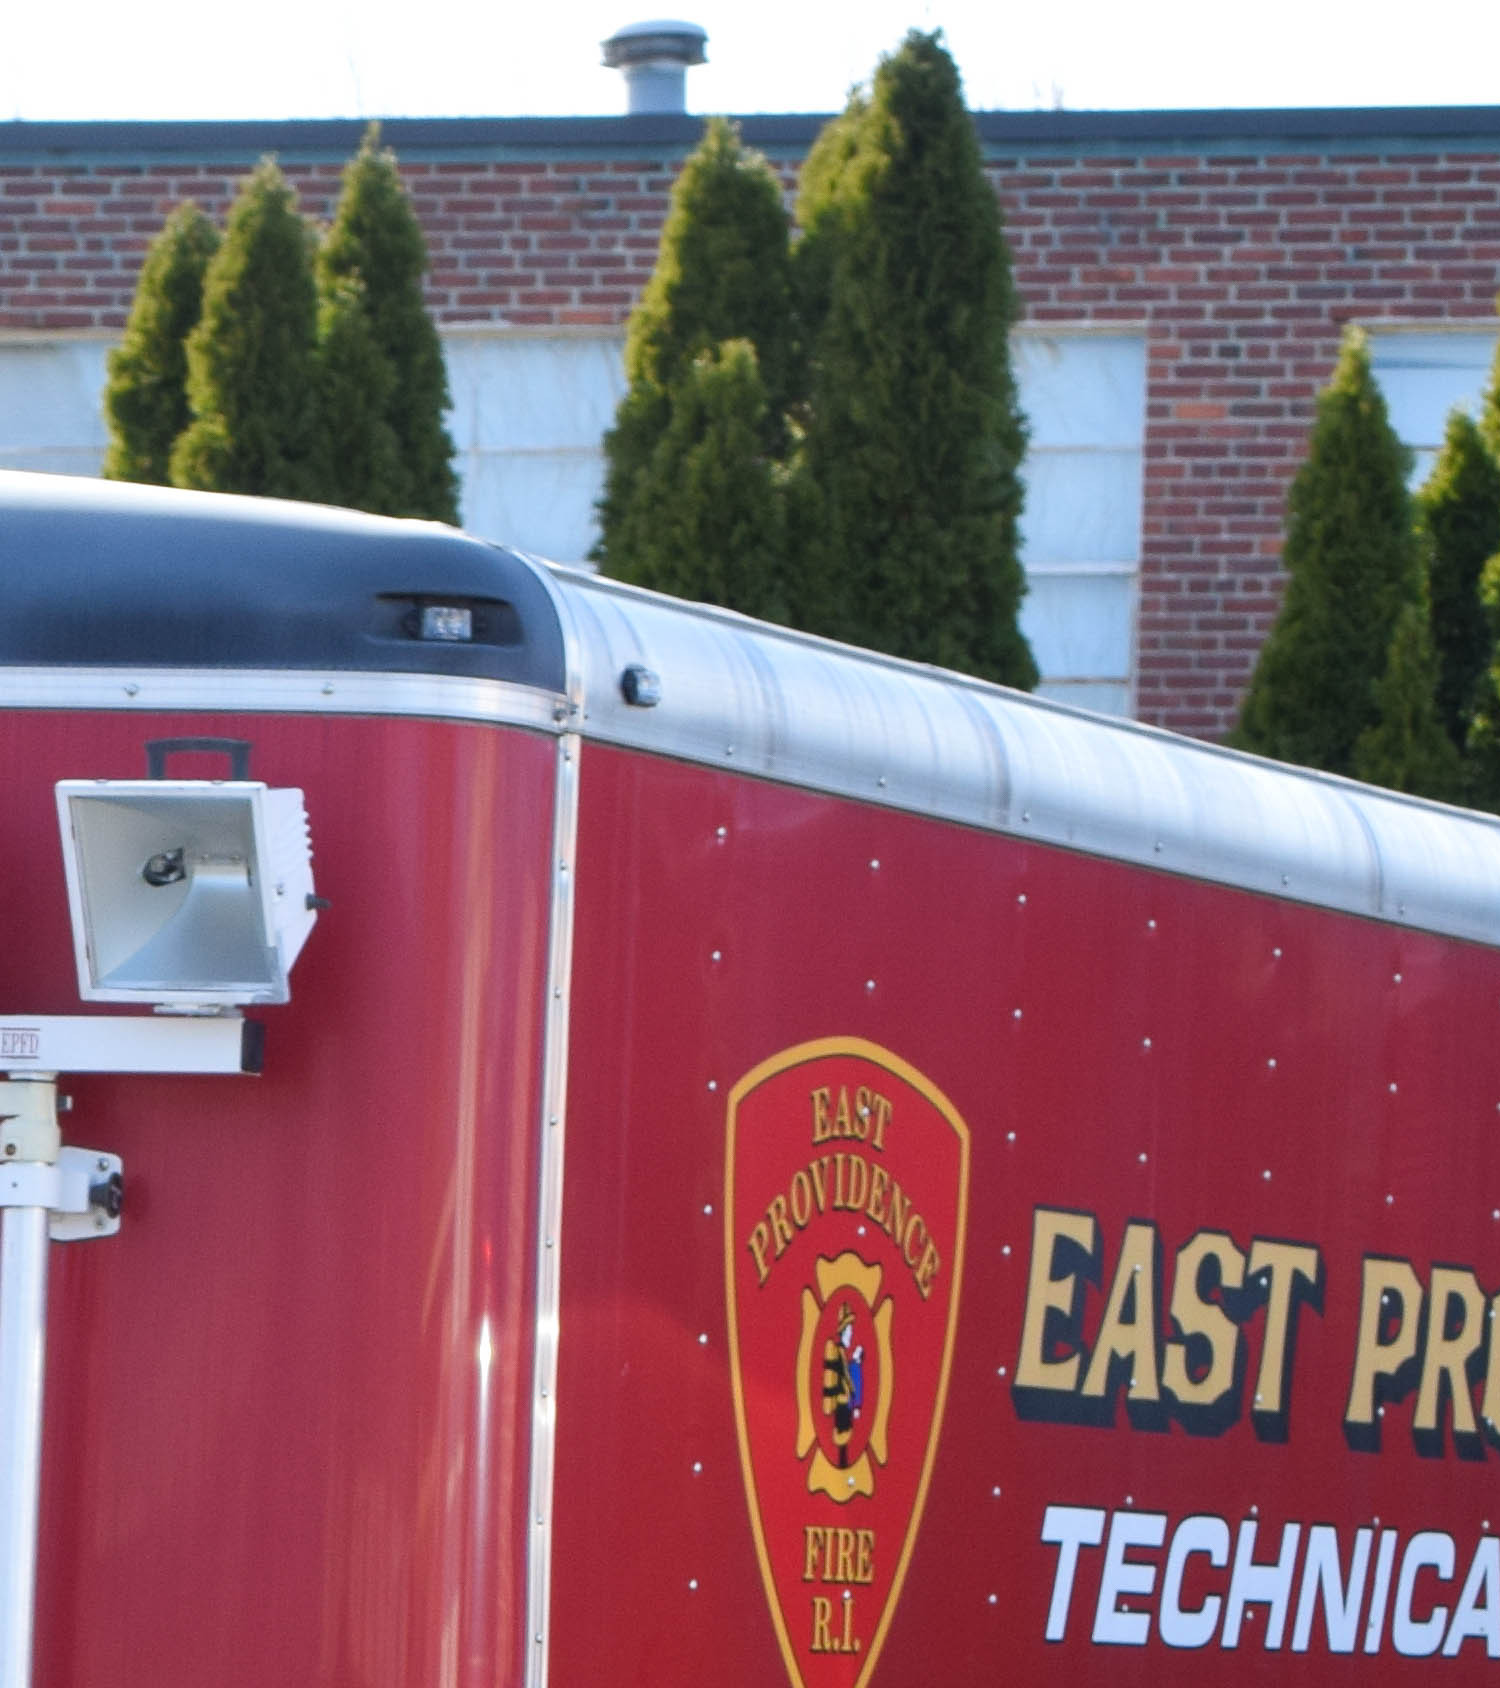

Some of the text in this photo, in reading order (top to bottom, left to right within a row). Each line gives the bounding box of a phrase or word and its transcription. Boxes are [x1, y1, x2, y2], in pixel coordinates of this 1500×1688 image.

[810, 1085, 893, 1152] EAST
[747, 1153, 940, 1301] PROVIDENCE
[1010, 1204, 1326, 1445] EAST
[803, 1526, 874, 1585] FIRE
[810, 1596, 860, 1654] R.I.
